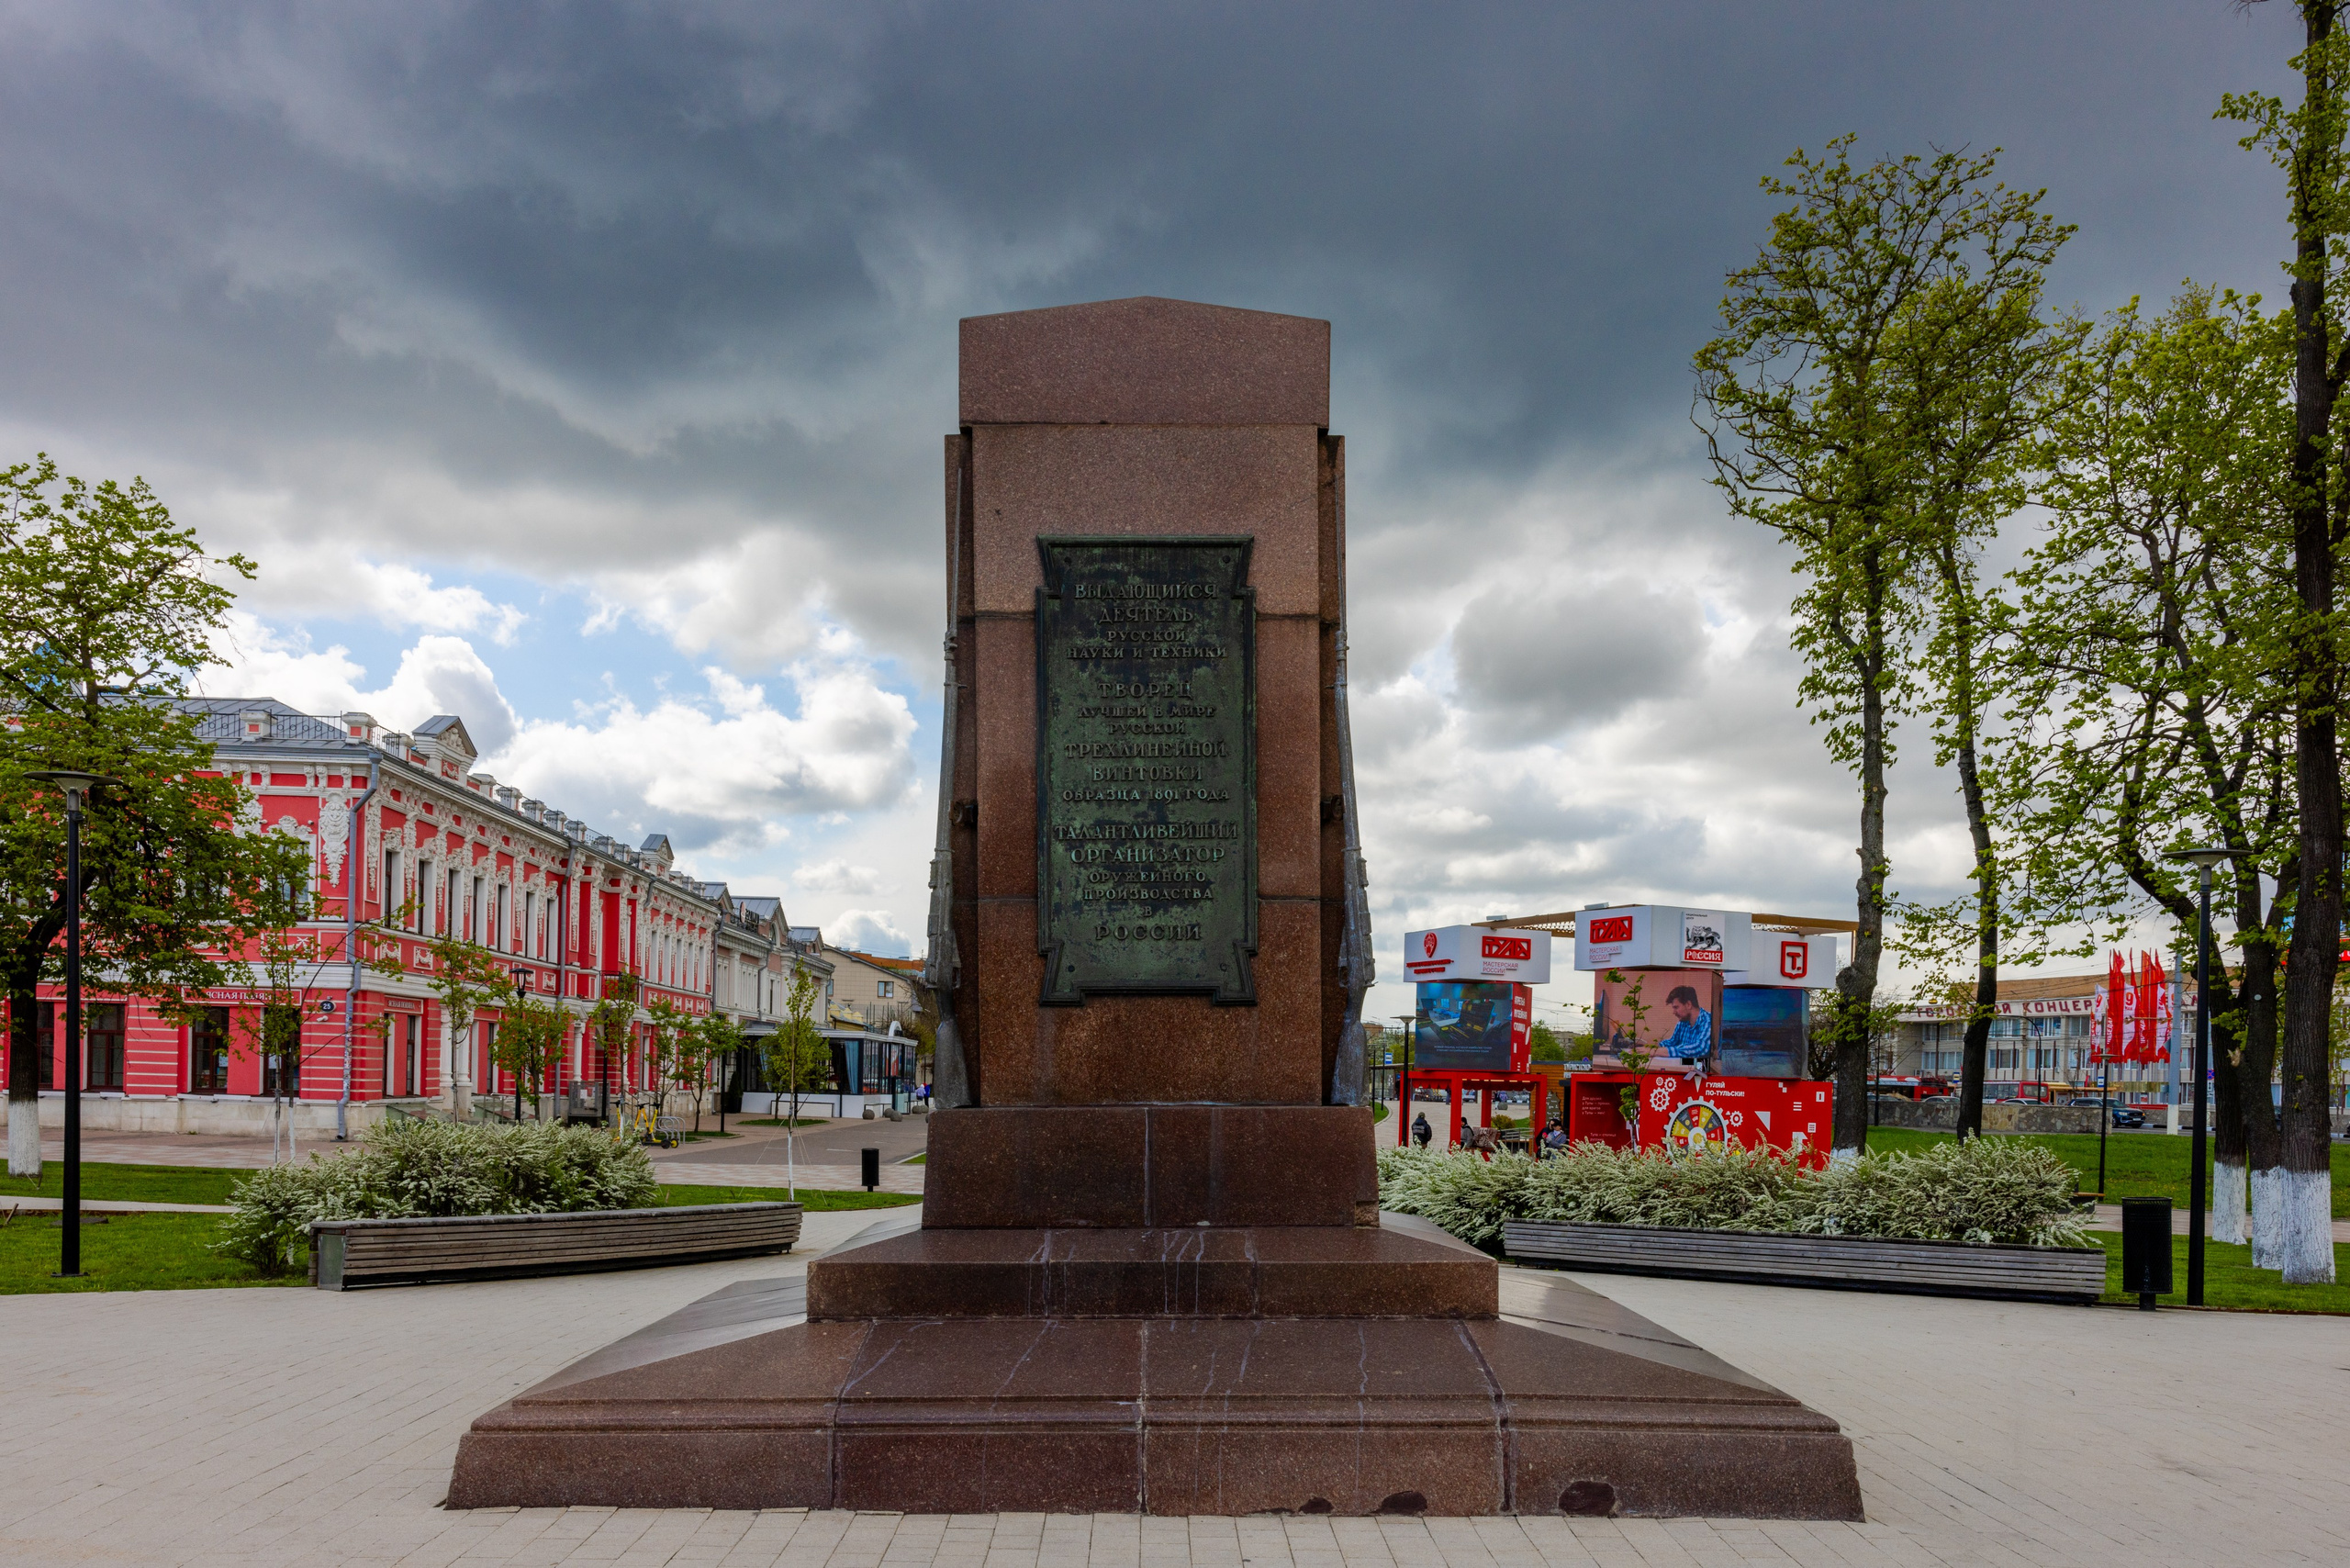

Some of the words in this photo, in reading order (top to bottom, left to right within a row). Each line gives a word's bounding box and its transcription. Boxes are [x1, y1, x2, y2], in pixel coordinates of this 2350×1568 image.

[1074, 581, 1218, 600] ВЫДАЮЩИЙСЯ
[1099, 607, 1194, 623] ДЕЯТЕЛЬ
[1107, 629, 1186, 642] РУССКОЙ
[1066, 647, 1125, 659] НАУКИ
[1132, 647, 1144, 658] И
[1151, 645, 1229, 658] ТЕХНИКИ
[1097, 682, 1194, 700] ТВОРЕЦ
[1077, 704, 1147, 718] ЛУЧШЕЙ
[1154, 706, 1163, 717] В
[1169, 705, 1216, 718] МИРЕ
[1108, 721, 1186, 734] РУССКОЙ
[1064, 738, 1227, 758] ТРЕХЛИНЕЙНОЙ
[1091, 766, 1203, 781] ВИНТОВКИ
[1062, 790, 1141, 802] ОБРАЗЦА
[1148, 788, 1180, 803] 1891
[1185, 789, 1230, 801] ГОДА
[1056, 821, 1238, 840] ТАЛАНТЛИВЕЙШИЙ
[1070, 847, 1225, 863] ОРГАНИЗАТОР
[1089, 870, 1206, 883] ОРУЖЕЙНОГО
[1084, 888, 1214, 901] ПРОИЗВОДСТВА
[1143, 906, 1152, 917] В
[1095, 924, 1202, 940] РОССИИ
[1686, 950, 1722, 961] РОССИЯ
[206, 991, 238, 1000] ЯСНАЯ
[2125, 991, 2133, 1006] 9
